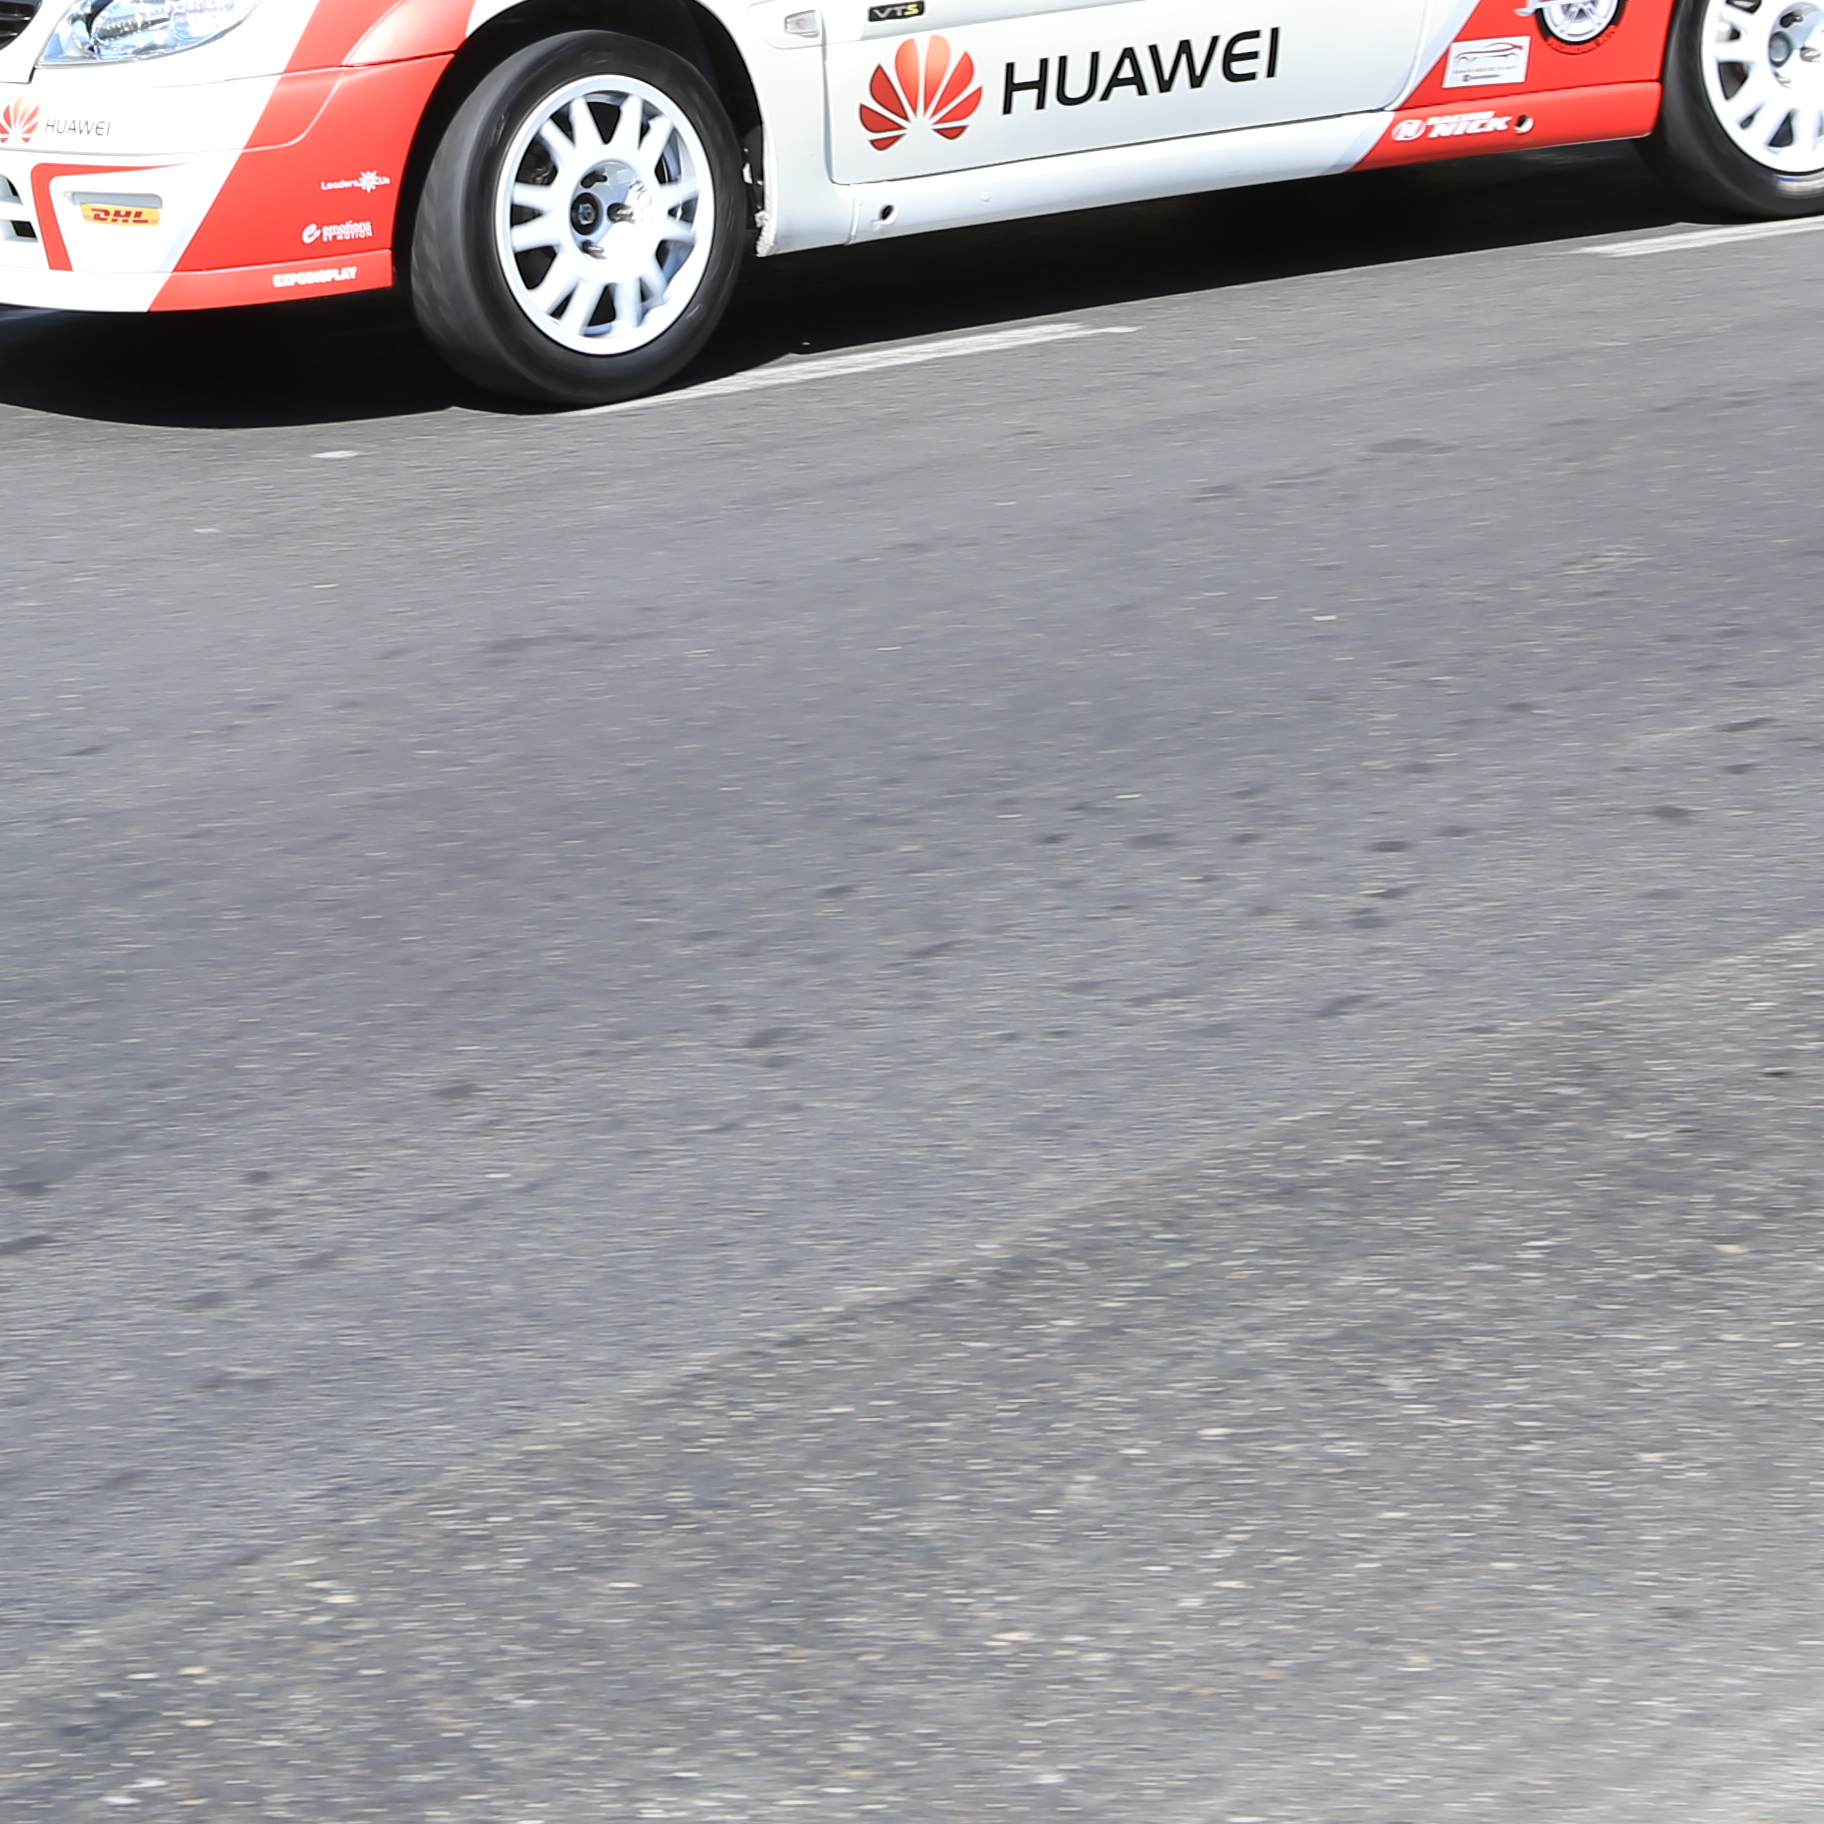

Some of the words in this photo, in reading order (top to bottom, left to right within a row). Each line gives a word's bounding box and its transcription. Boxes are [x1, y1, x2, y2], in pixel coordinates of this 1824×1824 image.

[873, 3, 920, 19] VTS
[1002, 27, 1281, 116] HUAWEI
[44, 118, 112, 137] HUAWEI
[1428, 116, 1513, 139] NICK
[321, 179, 360, 191] Leaders
[90, 208, 150, 224] DHL
[322, 220, 373, 236] emotions
[272, 266, 358, 288] EXPODISPLAY
